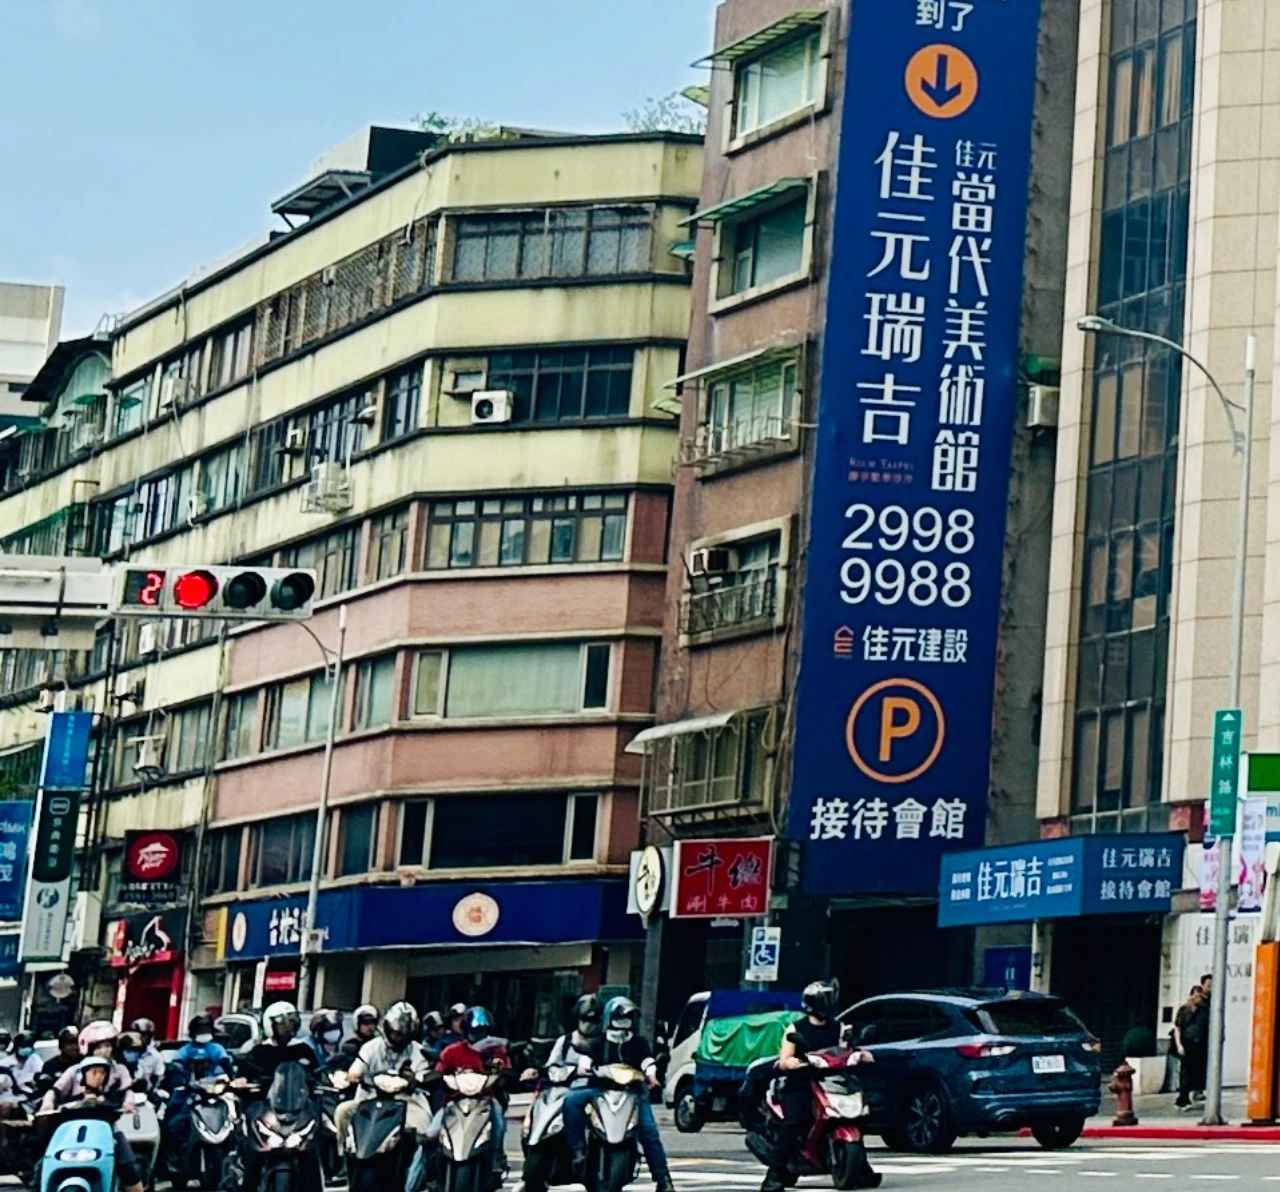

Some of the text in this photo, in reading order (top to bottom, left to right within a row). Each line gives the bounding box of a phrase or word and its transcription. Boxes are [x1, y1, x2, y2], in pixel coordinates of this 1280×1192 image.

[915, 0, 974, 32] 到了
[954, 138, 998, 170] 佳元
[857, 131, 938, 445] 佳元瑞吉
[931, 171, 997, 492] 當代美術館
[841, 503, 975, 554] 2998
[839, 557, 972, 608] 9988
[862, 625, 968, 664] 佳元建設
[879, 696, 921, 763] P
[809, 797, 967, 841] 接待會館
[977, 855, 1044, 901] 佳元瑞吉
[1102, 848, 1171, 869] 佳元瑞吉
[1100, 880, 1171, 900] 接待會館
